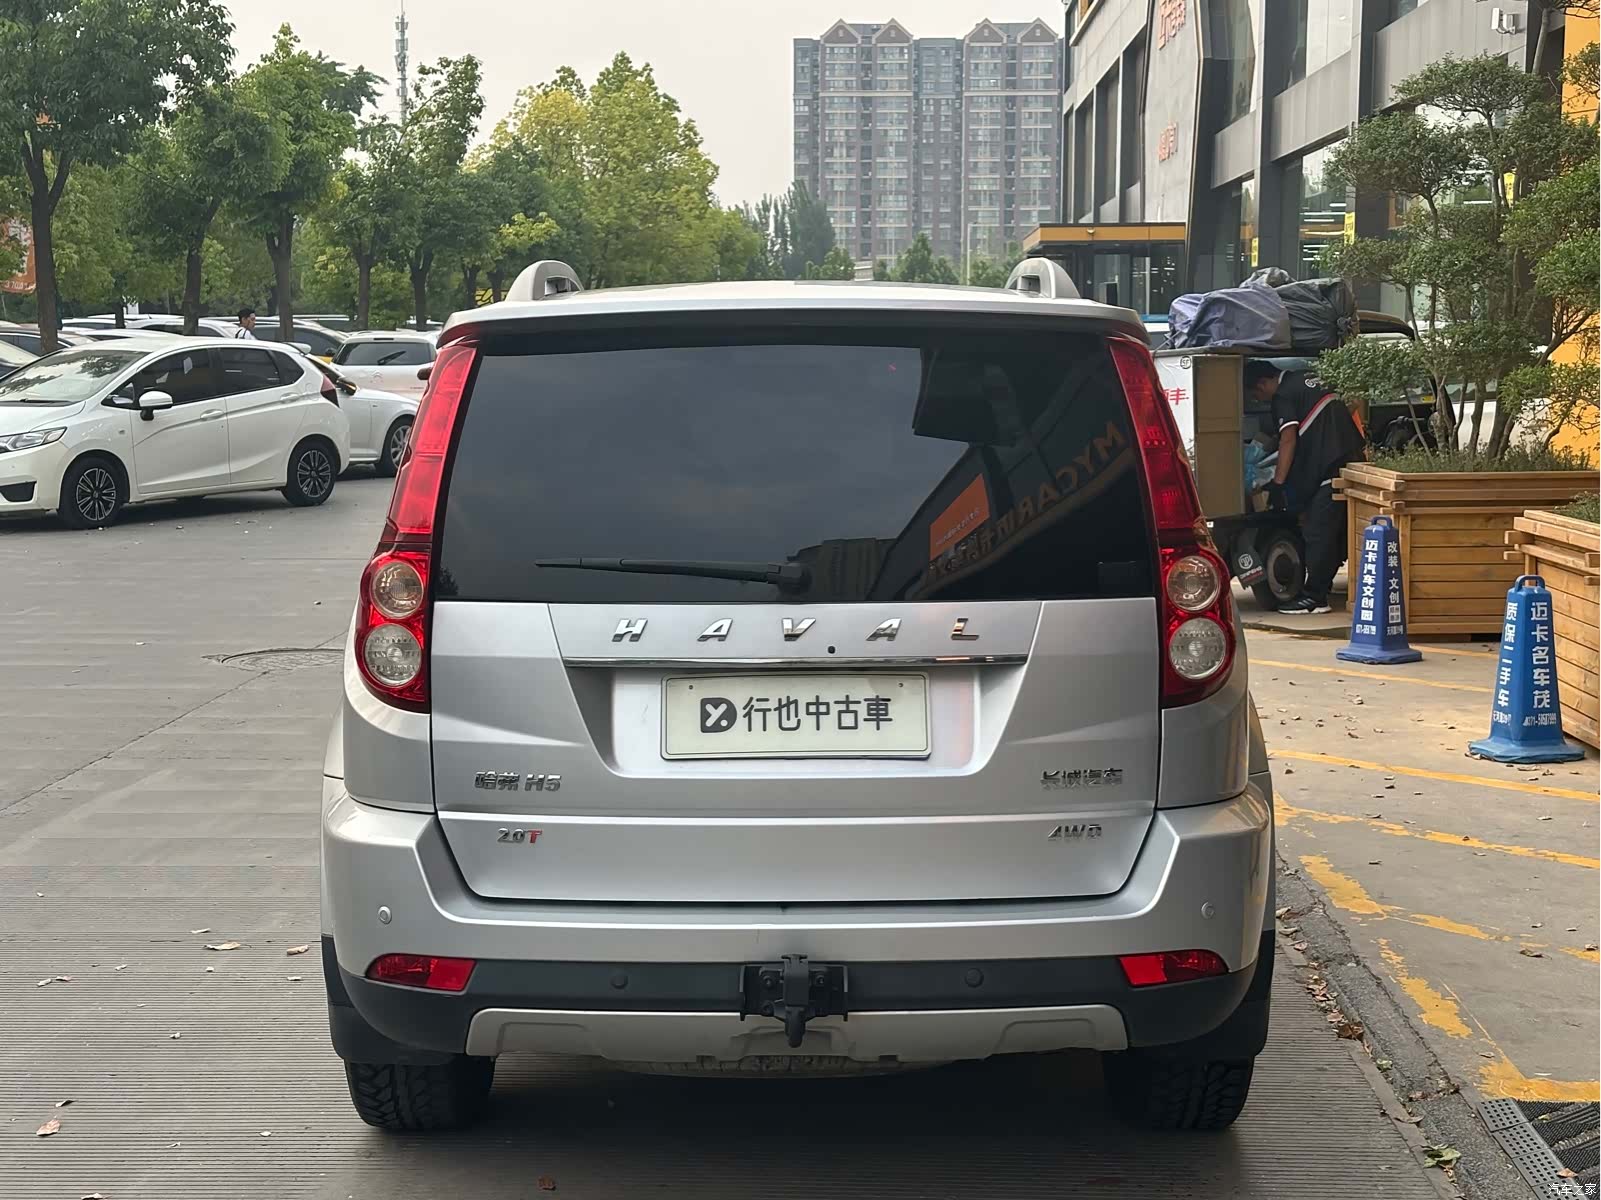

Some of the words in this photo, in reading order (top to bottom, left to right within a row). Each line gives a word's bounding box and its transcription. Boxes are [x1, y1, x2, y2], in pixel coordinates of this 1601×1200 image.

[611, 618, 980, 643] HAVAL
[1497, 602, 1518, 707] 质保二手车
[1530, 602, 1551, 709] 迈卡名车茂
[742, 694, 893, 733] 行也中古車
[525, 774, 562, 791] H5
[1048, 824, 1102, 841] 4WD
